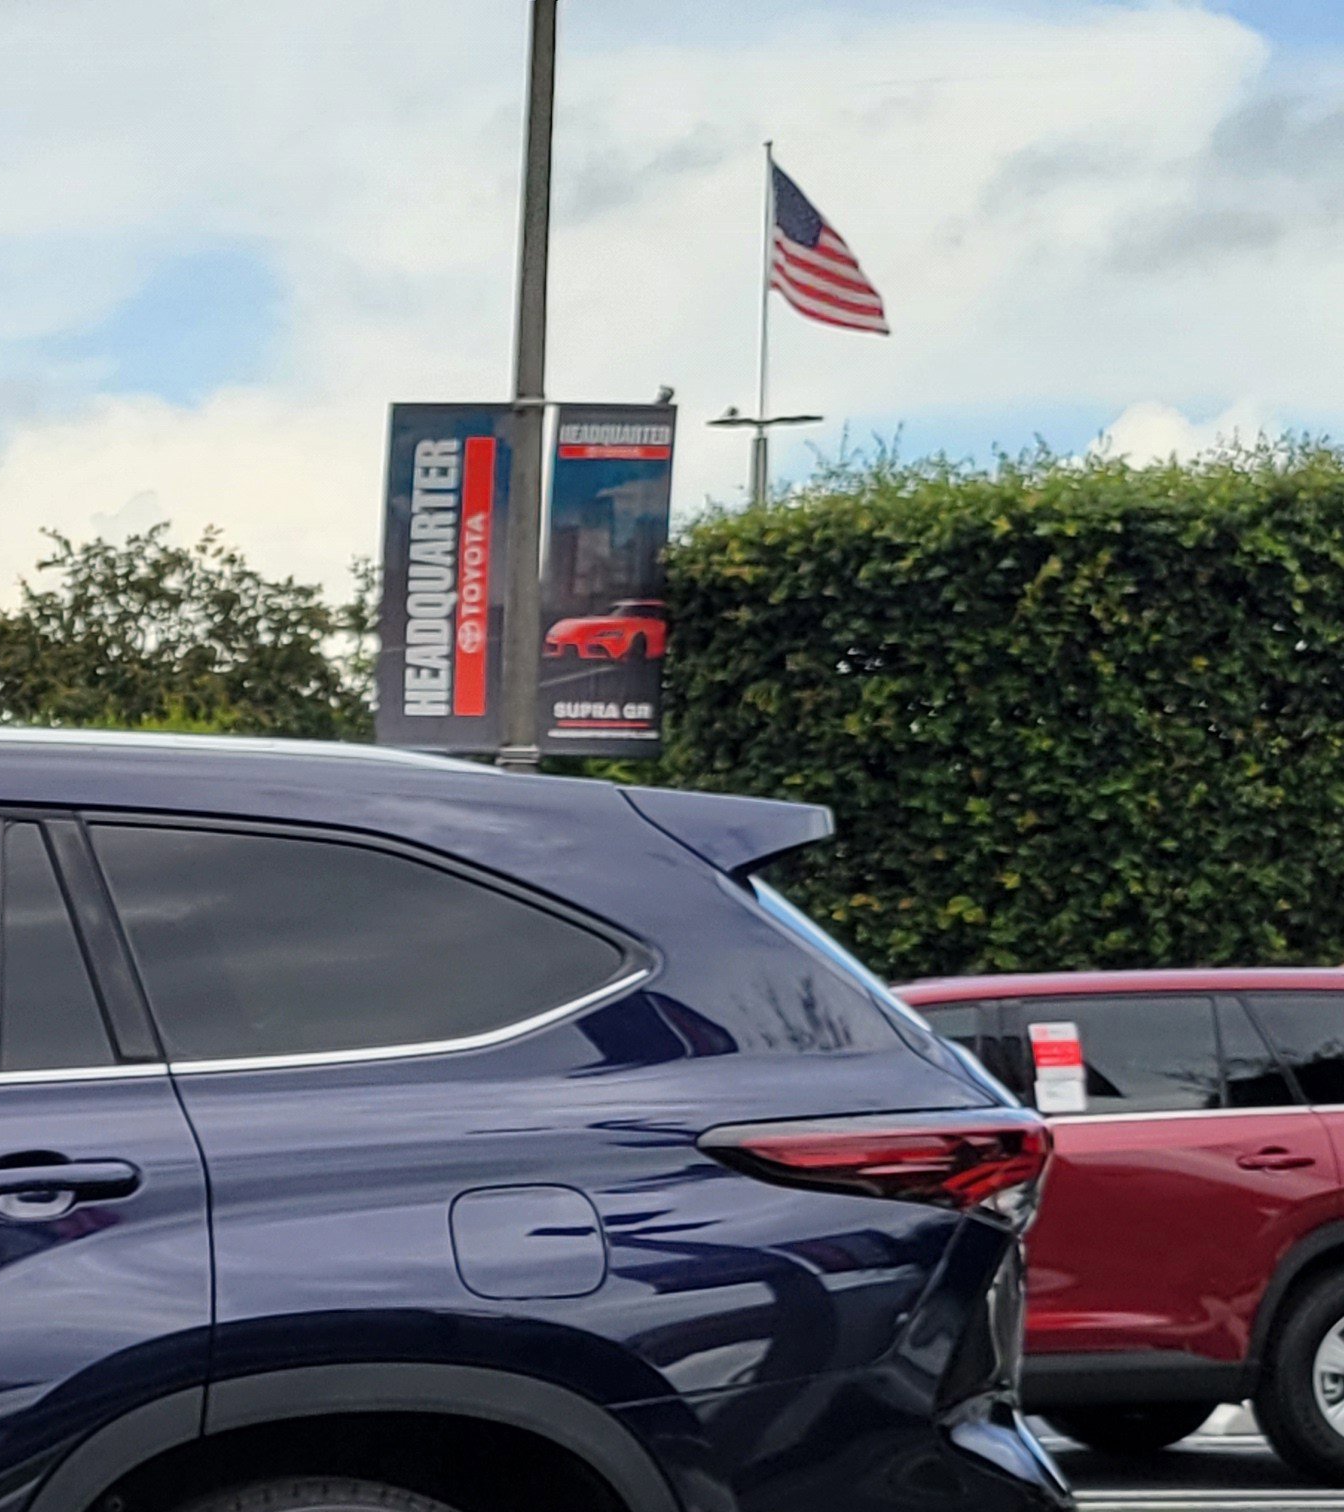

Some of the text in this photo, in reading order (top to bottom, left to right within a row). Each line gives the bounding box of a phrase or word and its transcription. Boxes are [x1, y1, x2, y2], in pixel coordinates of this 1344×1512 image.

[404, 438, 461, 717] HEADQUARTER
[463, 512, 487, 615] TOYOTA
[553, 702, 653, 719] SUPRA GR
